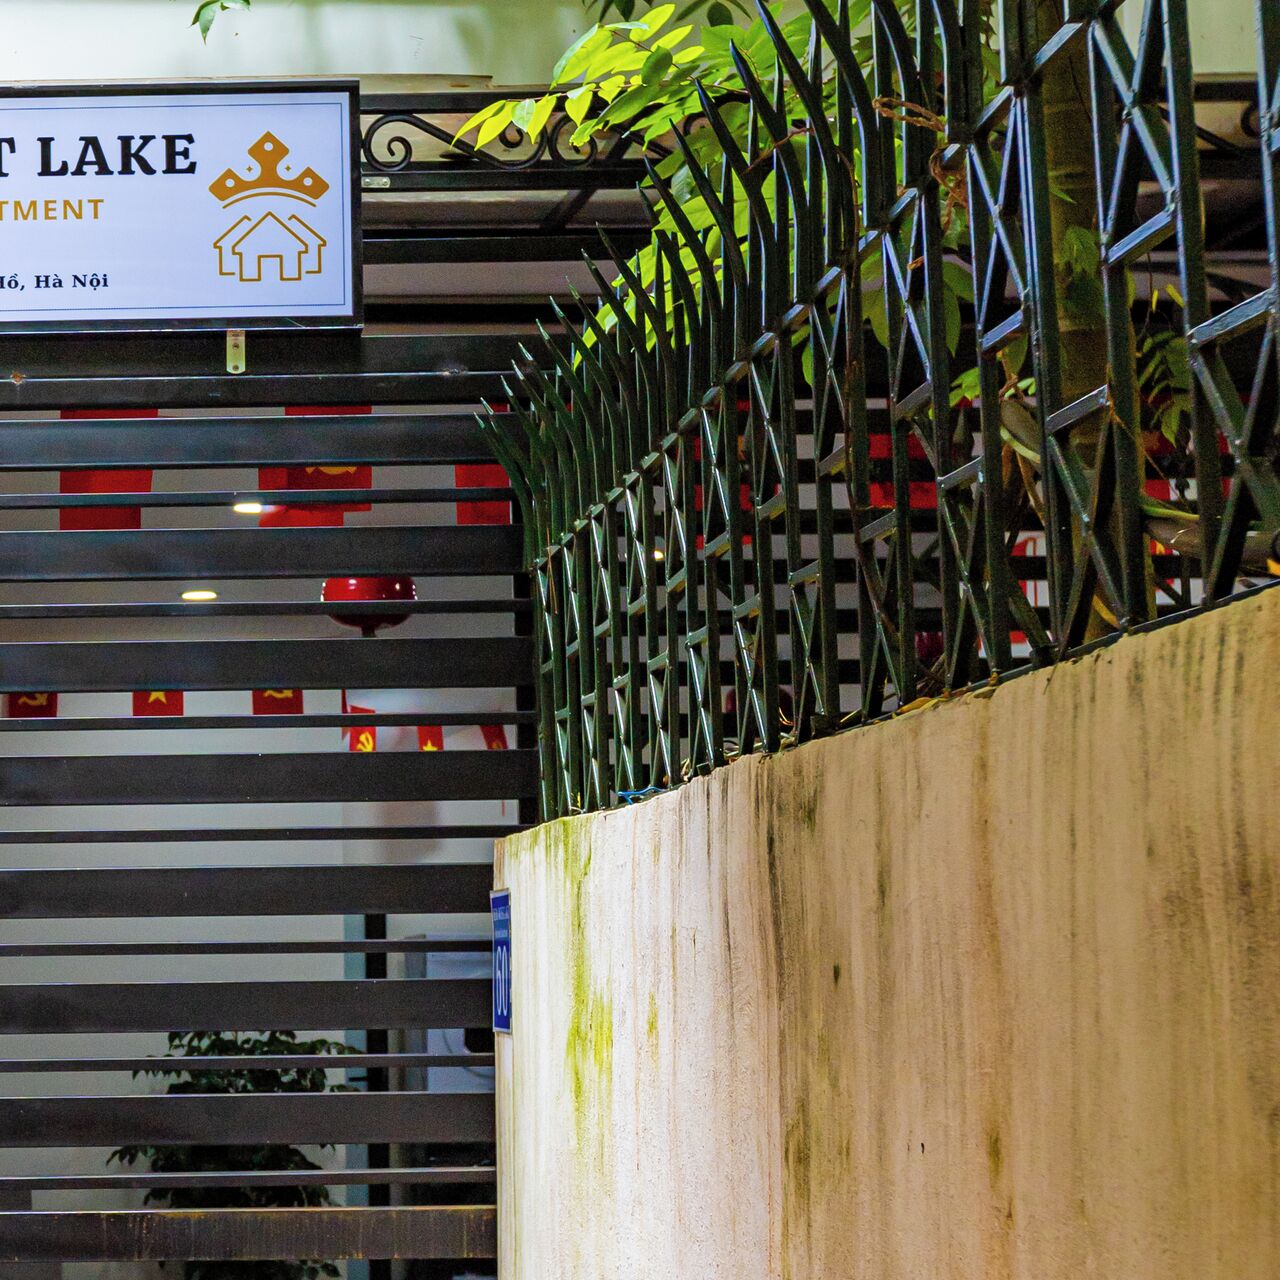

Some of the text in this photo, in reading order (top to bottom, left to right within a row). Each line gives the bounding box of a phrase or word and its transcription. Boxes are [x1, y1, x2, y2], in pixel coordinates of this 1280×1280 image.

[37, 134, 197, 176] LAKE
[35, 274, 63, 288] Hà
[72, 273, 108, 290] Nội
[496, 946, 508, 1016] 60
